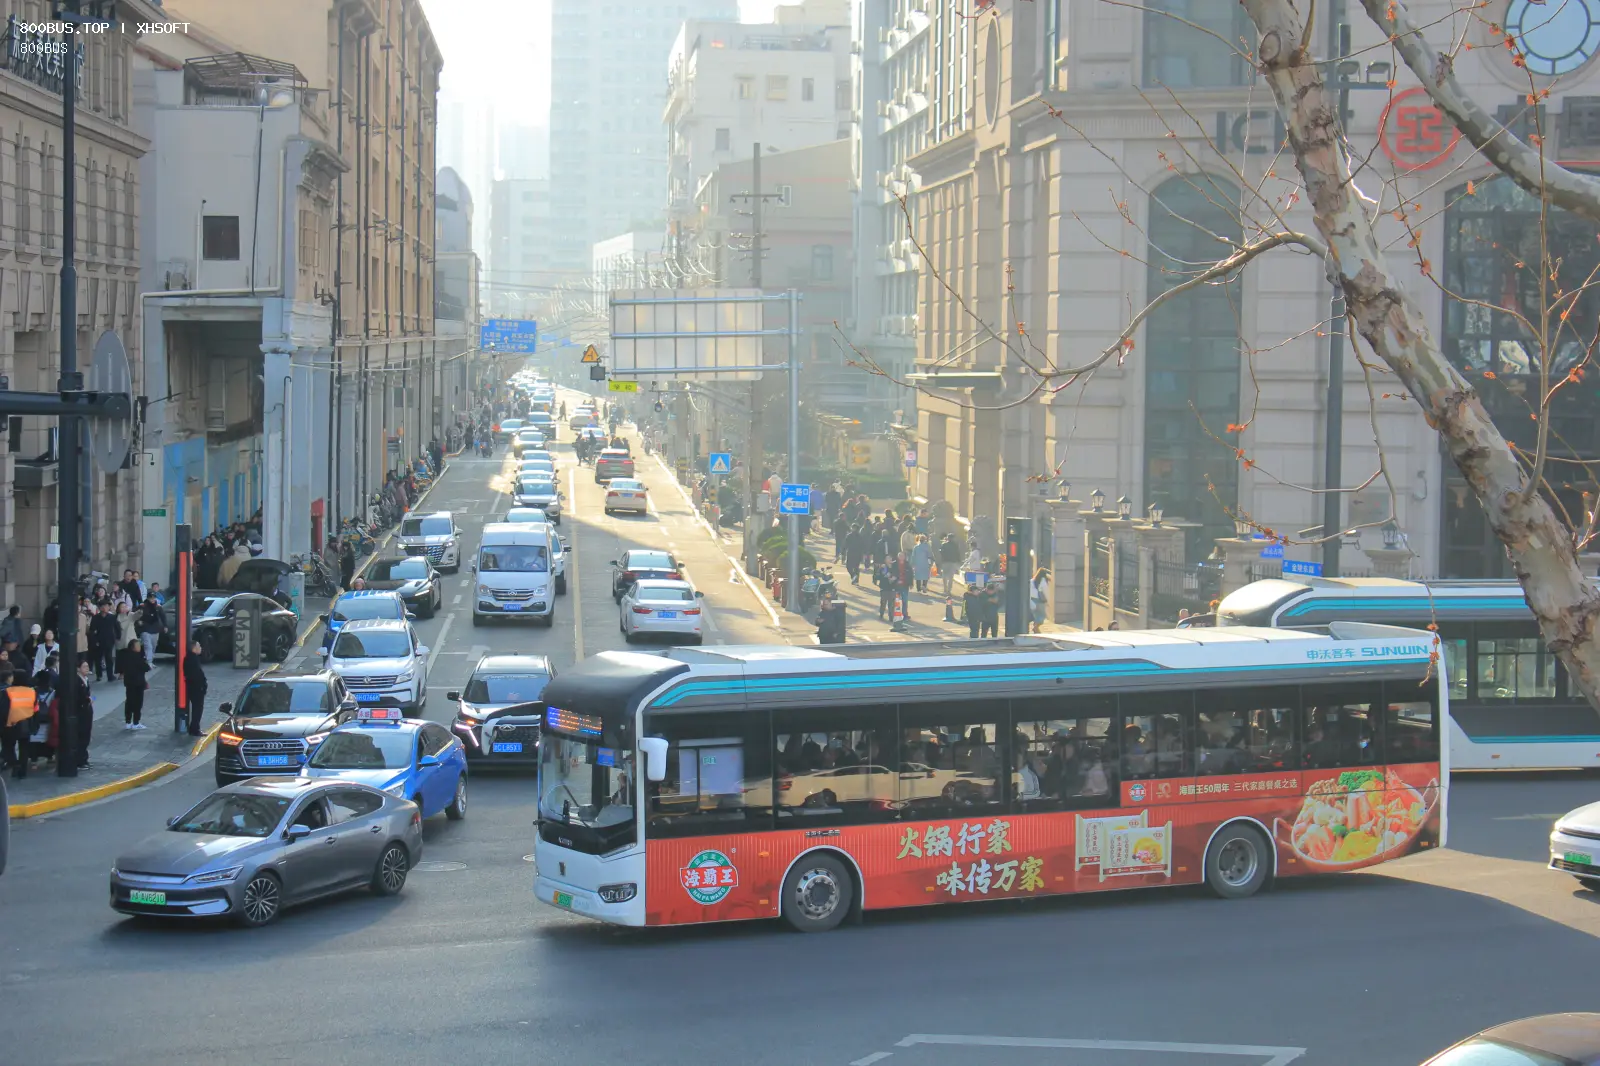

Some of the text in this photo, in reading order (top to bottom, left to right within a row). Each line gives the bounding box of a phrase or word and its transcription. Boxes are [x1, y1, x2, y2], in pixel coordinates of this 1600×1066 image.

[781, 487, 809, 496] 下一路口
[1306, 648, 1355, 660] 申沃客车
[1361, 645, 1429, 657] SUNWIN
[1179, 783, 1230, 796] 海霸王50周年
[1234, 779, 1298, 792] 三代家庭餐桌之选
[896, 819, 1012, 859] 火锅行家
[685, 868, 734, 887] 海霸王
[936, 856, 1045, 896] 味传万家
